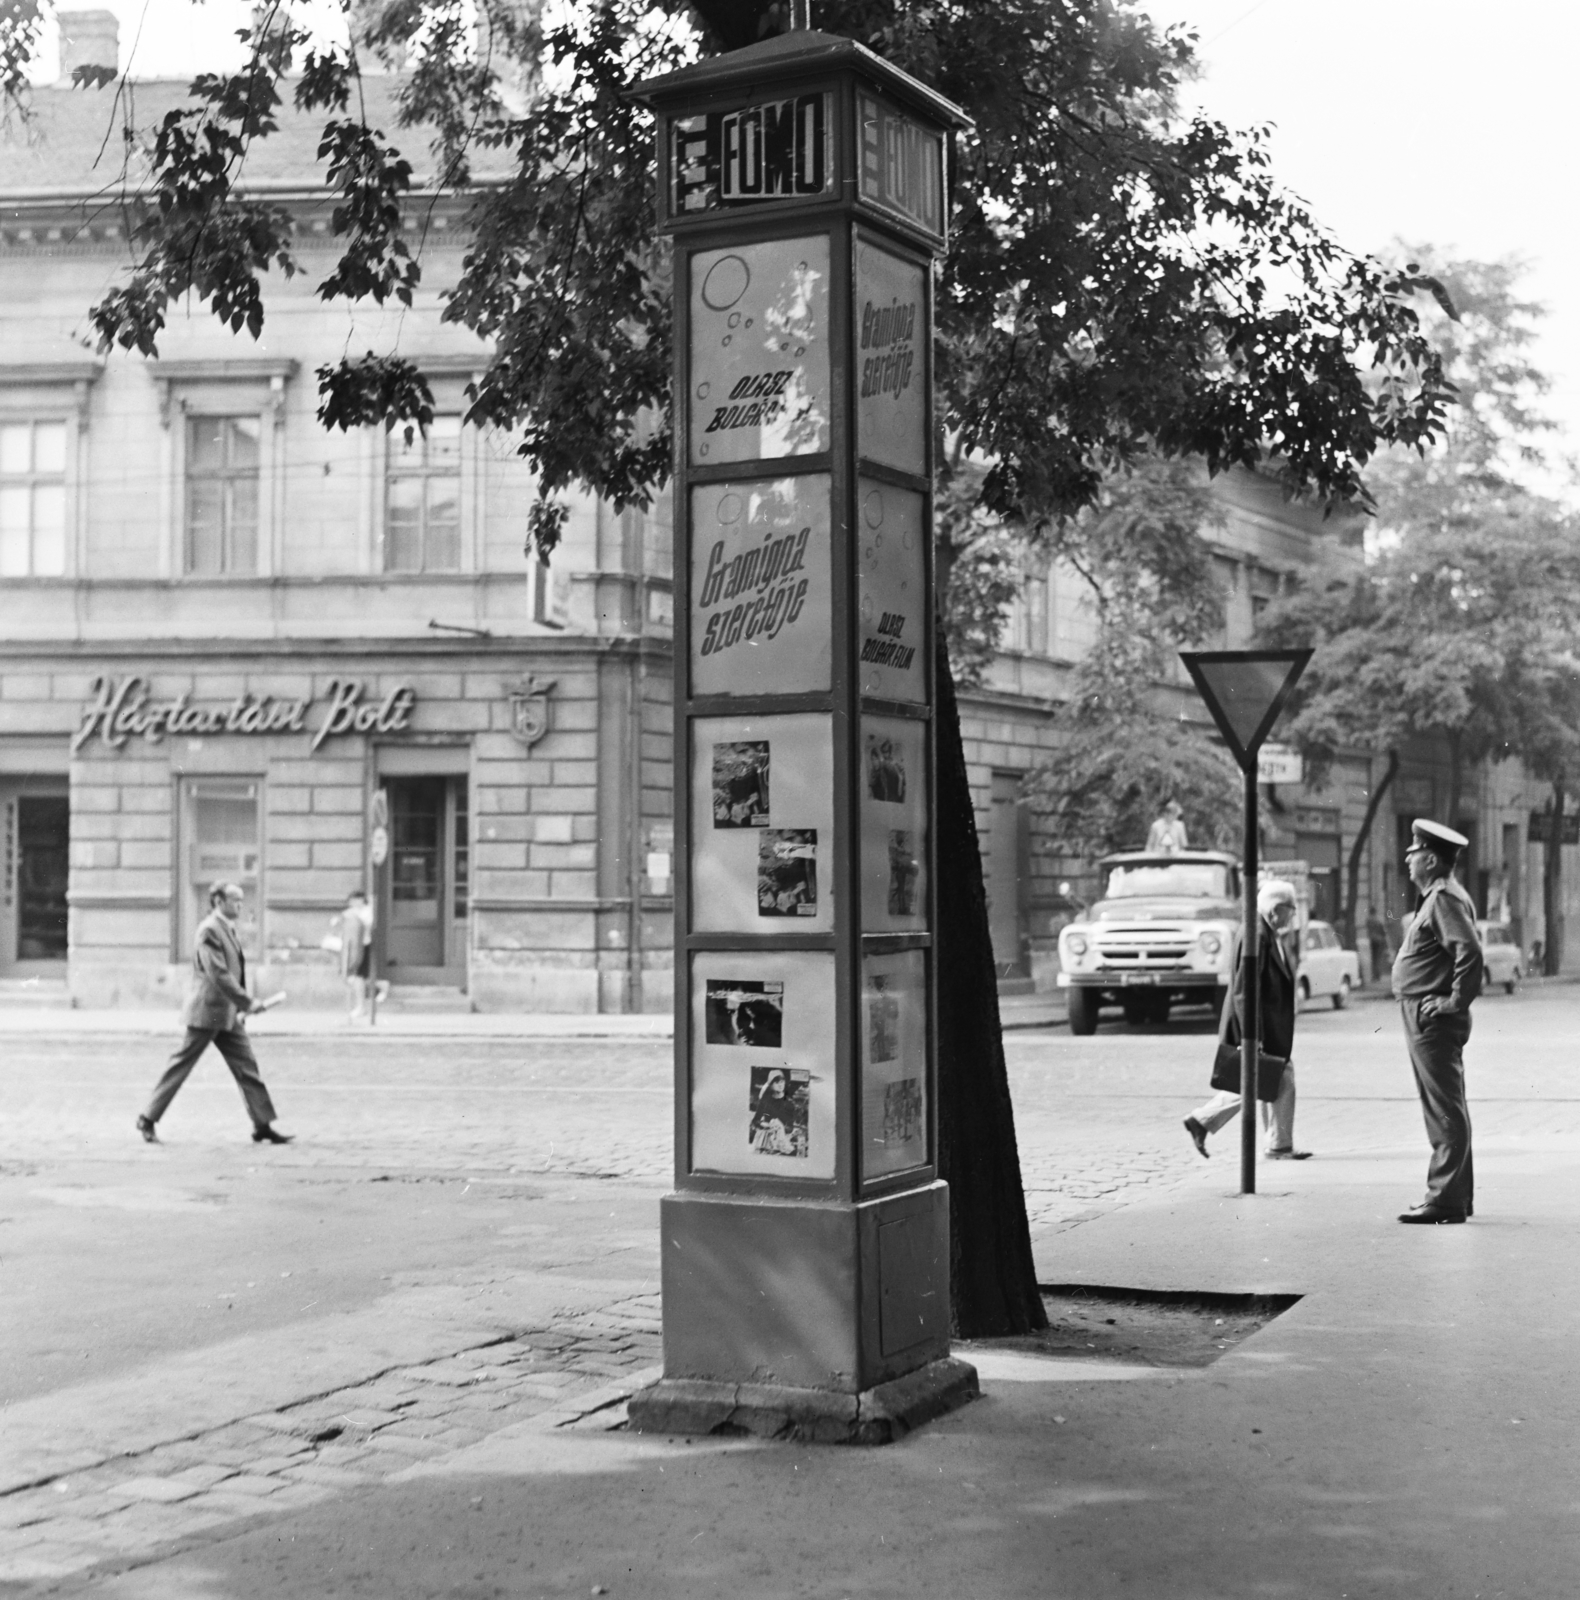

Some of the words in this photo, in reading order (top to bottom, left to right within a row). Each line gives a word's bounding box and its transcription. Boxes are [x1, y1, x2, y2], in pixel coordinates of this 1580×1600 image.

[728, 370, 794, 400] OLASZ
[699, 527, 812, 609] Gramigna
[700, 576, 810, 656] szeretője
[877, 611, 905, 639] OLASZ
[69, 677, 306, 750] Háztartási
[311, 679, 414, 751] Bolt
